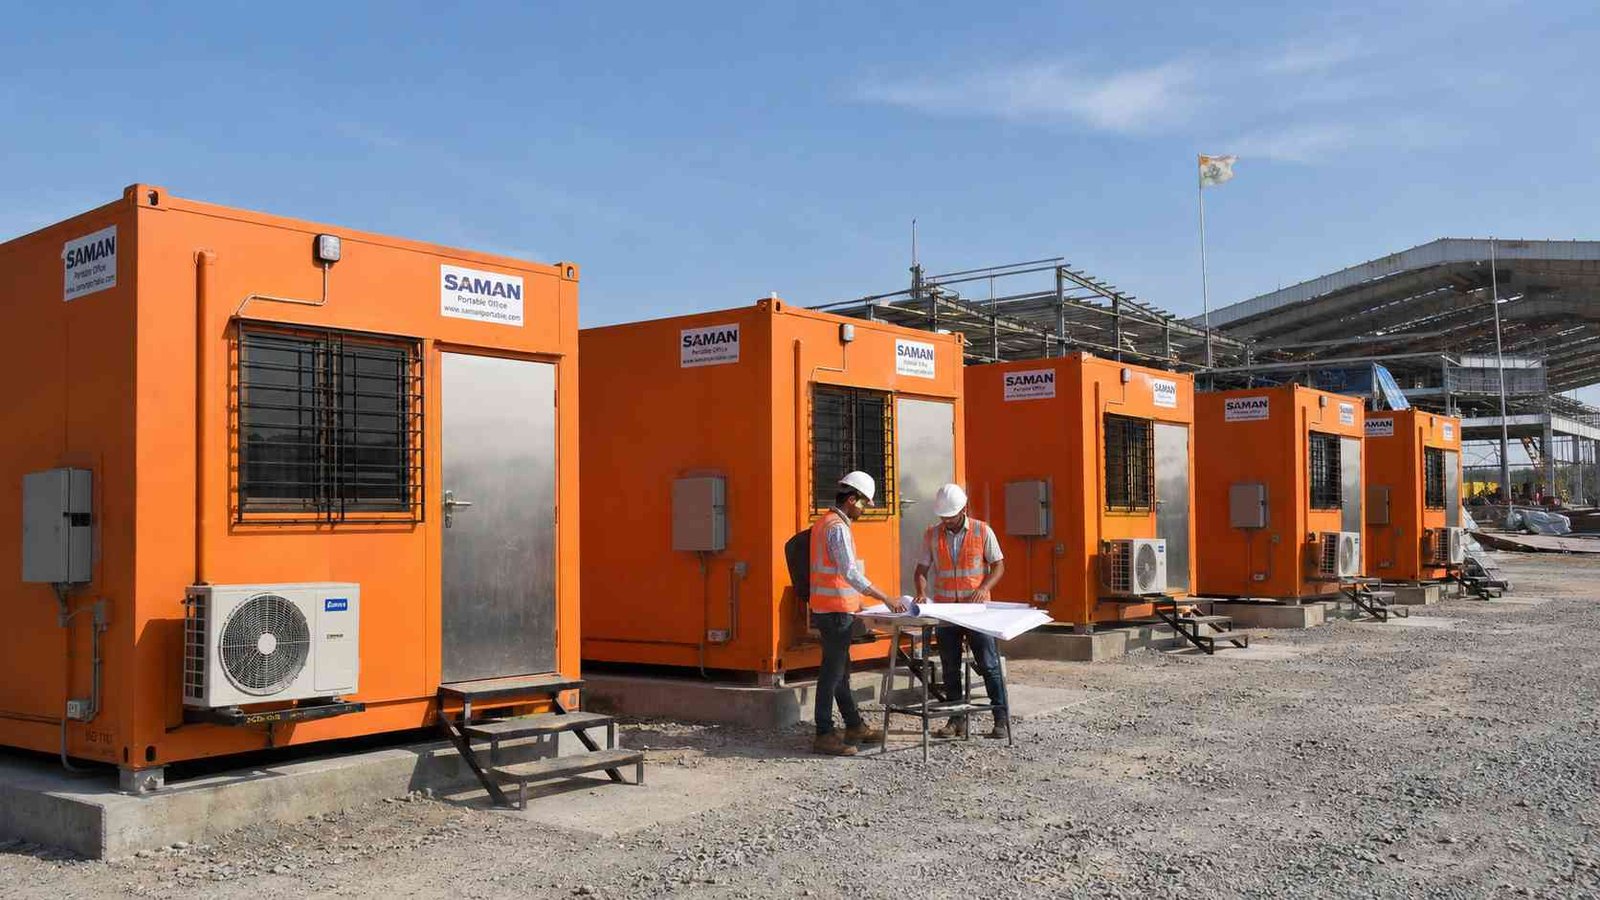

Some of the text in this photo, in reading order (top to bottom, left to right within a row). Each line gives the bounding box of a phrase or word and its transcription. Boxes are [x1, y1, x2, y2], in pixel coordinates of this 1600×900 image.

[66, 236, 115, 269] SAMAN
[444, 274, 520, 300] SAMAN
[457, 295, 507, 309] Portable Office
[683, 330, 737, 347] SAMAN
[897, 344, 933, 360] SAMAN
[1006, 373, 1053, 386] SAMAN
[1154, 382, 1175, 394] SAMAN
[1226, 400, 1267, 410] SAMAN
[1364, 420, 1392, 428] AMAN
